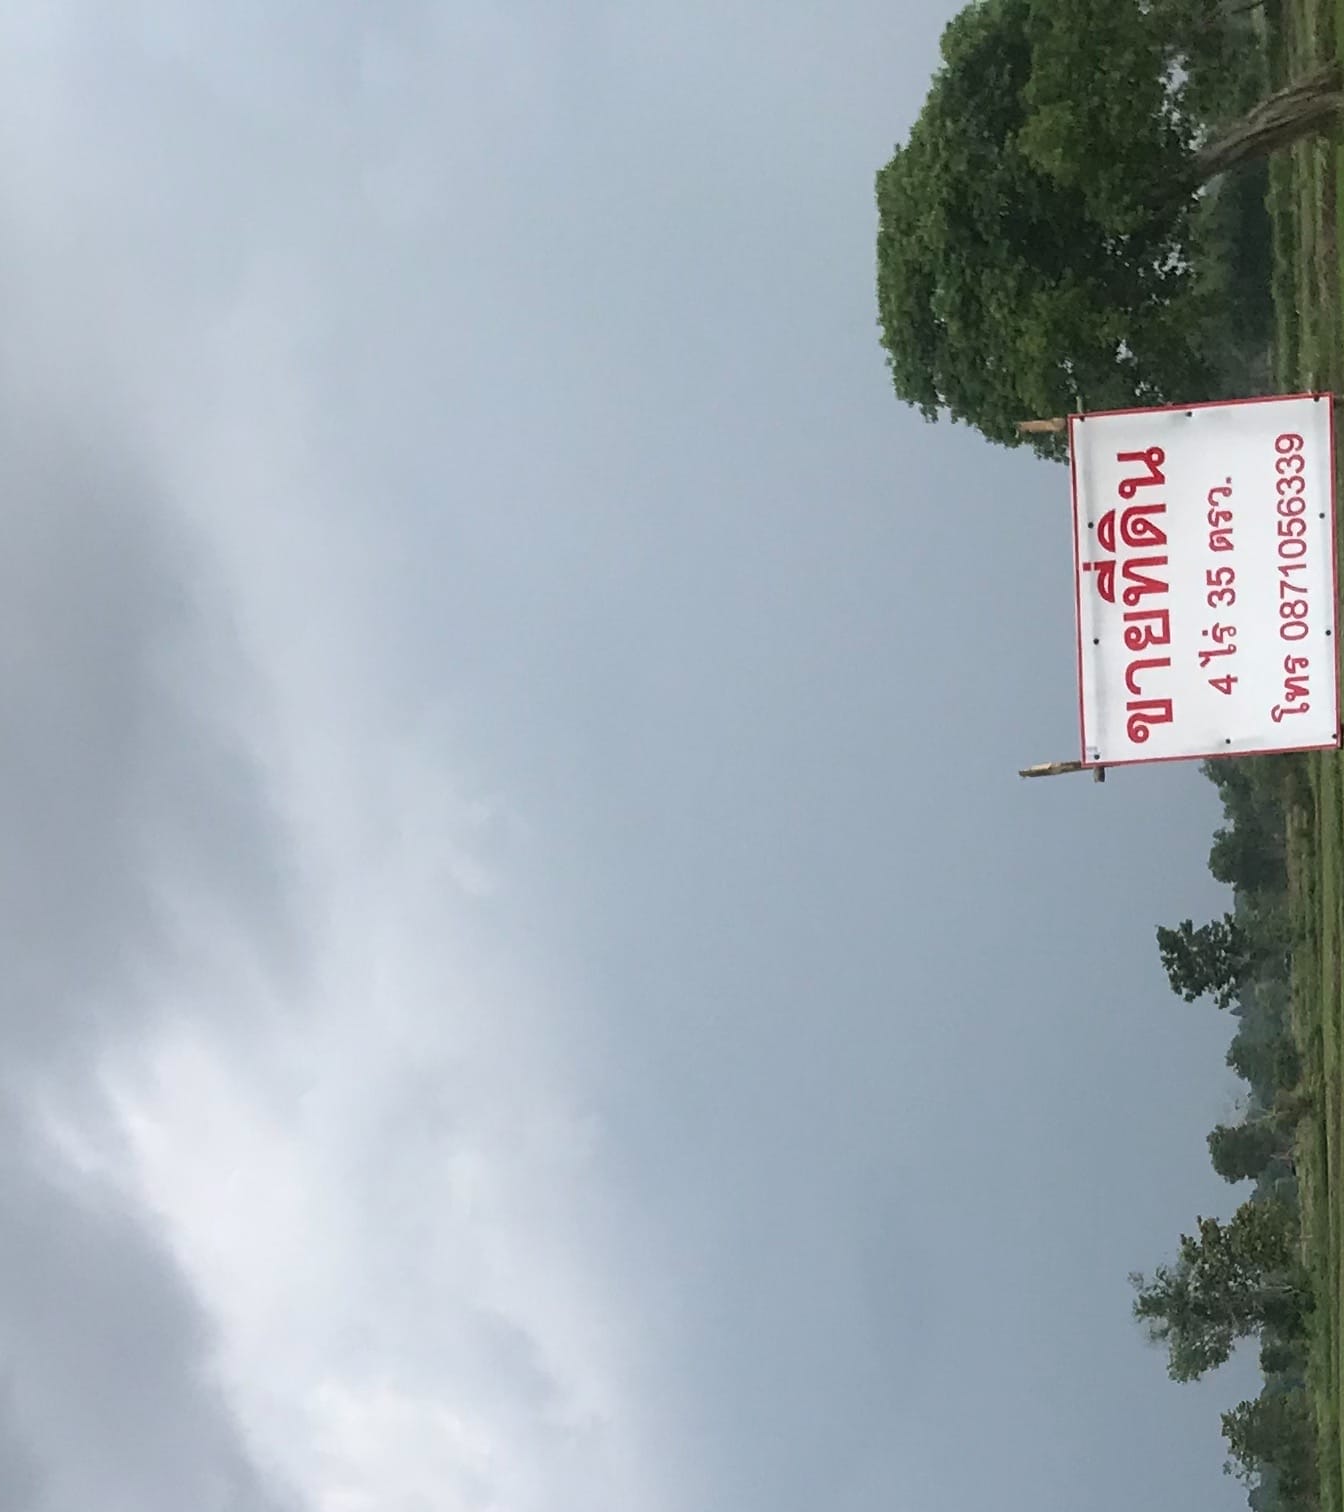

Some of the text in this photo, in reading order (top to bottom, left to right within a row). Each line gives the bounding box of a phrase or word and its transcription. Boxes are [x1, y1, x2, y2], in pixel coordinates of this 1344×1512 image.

[1083, 446, 1173, 743] ขายที่ดิน
[1199, 476, 1238, 695] 4 ไร่ 35 ตรว.
[1271, 432, 1310, 723] โทร 0871056339
